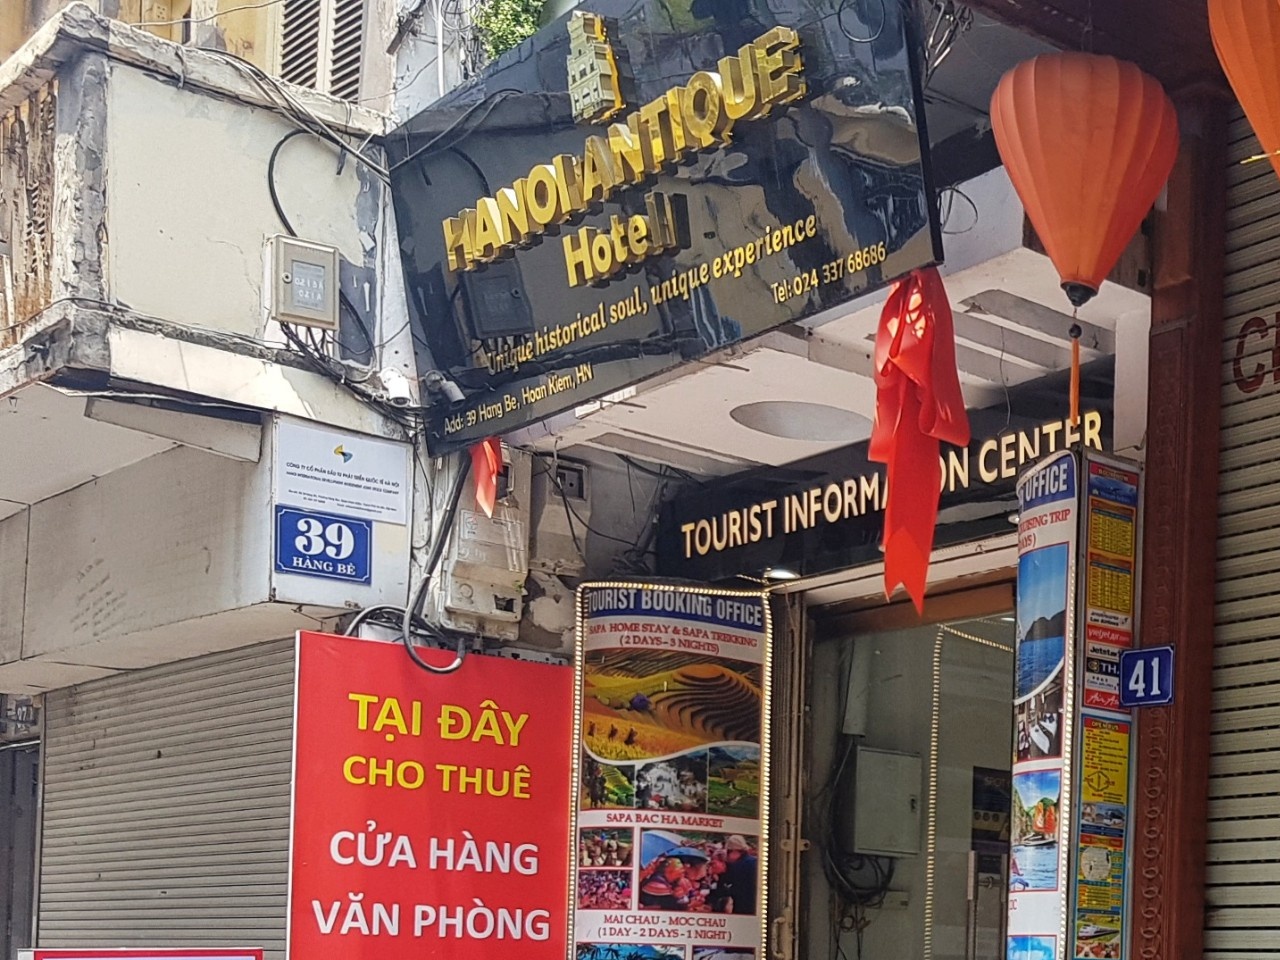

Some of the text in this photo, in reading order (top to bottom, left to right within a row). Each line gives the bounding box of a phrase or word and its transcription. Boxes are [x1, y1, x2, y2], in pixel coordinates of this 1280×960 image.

[442, 26, 806, 272] HANOI ANTIQUE
[563, 191, 678, 287] Hotel
[823, 259, 845, 284] 337
[847, 241, 886, 274] 68686
[487, 215, 817, 375] Unique historical soul, unique experience
[444, 362, 593, 435] Add: 39 Hang Be, Hoan Kiem, HN
[681, 500, 778, 559] TOURIST
[977, 410, 1103, 483] CENTER
[1049, 508, 1071, 524] TRIP
[295, 517, 355, 560] 39
[292, 555, 333, 573] HÀNG
[588, 588, 762, 626] TOURIST BOOKING OFFICE
[589, 623, 758, 648] SAPA HOME STAY & SAPA TREKKING
[678, 638, 719, 655] NIGHTS)
[1129, 656, 1161, 698] 41
[349, 693, 528, 746] TẠI ĐÂY
[343, 755, 531, 799] CHO THUÊ
[606, 813, 724, 828] SAPA BAC HA MARKET
[329, 820, 539, 875] CỬA HÀNG
[312, 892, 550, 941] VĂN PHÒNG
[603, 915, 726, 928] MAI CHAU MOC CHAU
[608, 928, 630, 937] DAY
[639, 928, 646, 937] 2
[647, 928, 679, 938] DAYS
